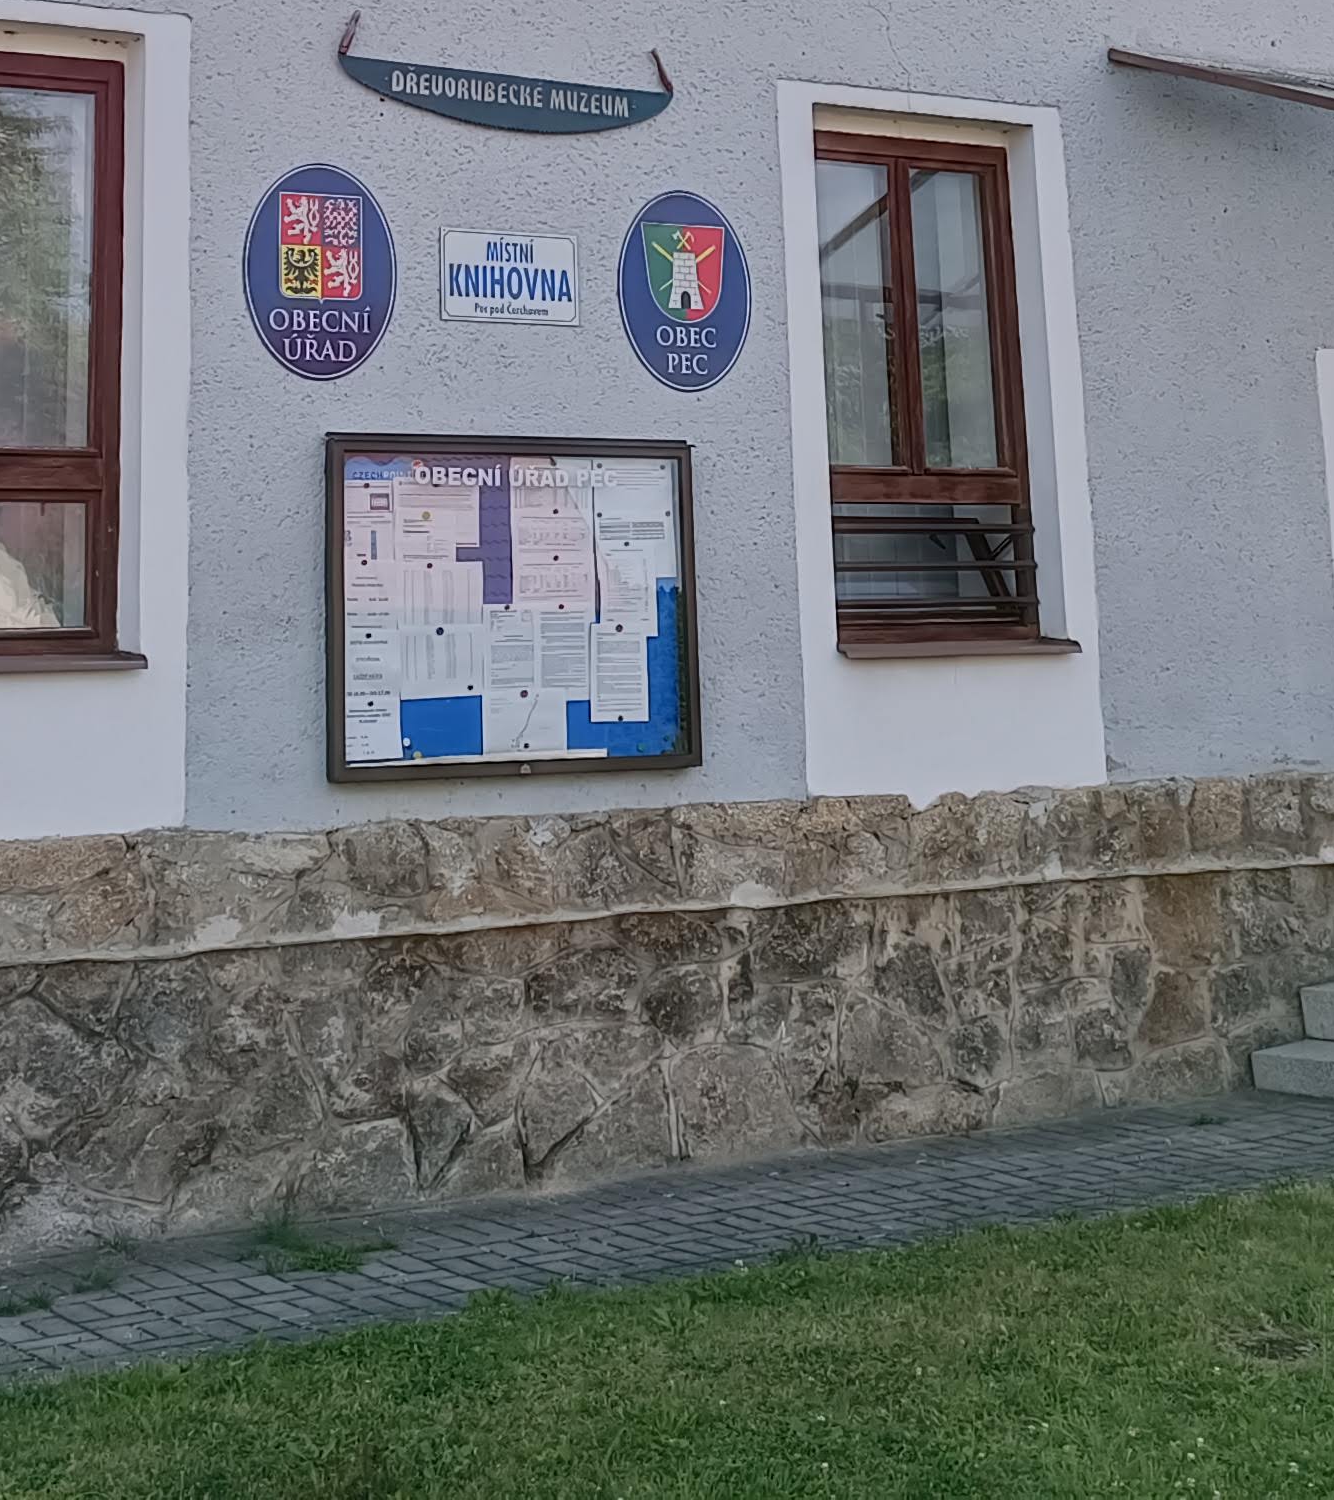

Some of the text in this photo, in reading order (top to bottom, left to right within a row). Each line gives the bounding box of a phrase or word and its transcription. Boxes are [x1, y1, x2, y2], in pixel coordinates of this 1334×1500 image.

[391, 66, 630, 118] DŘEVORUBECKÉ MUZEUM
[486, 237, 534, 264] MÍSTNÍ
[449, 263, 573, 302] KNIHOVNA
[269, 306, 371, 333] OBECNÍ
[474, 303, 487, 314] Pec
[489, 304, 505, 316] pod
[283, 333, 357, 362] ÚŘAD
[656, 325, 717, 348] OBEC
[667, 353, 708, 375] PEC
[414, 464, 619, 489] OBECNÍ ÚŘAD PEC
